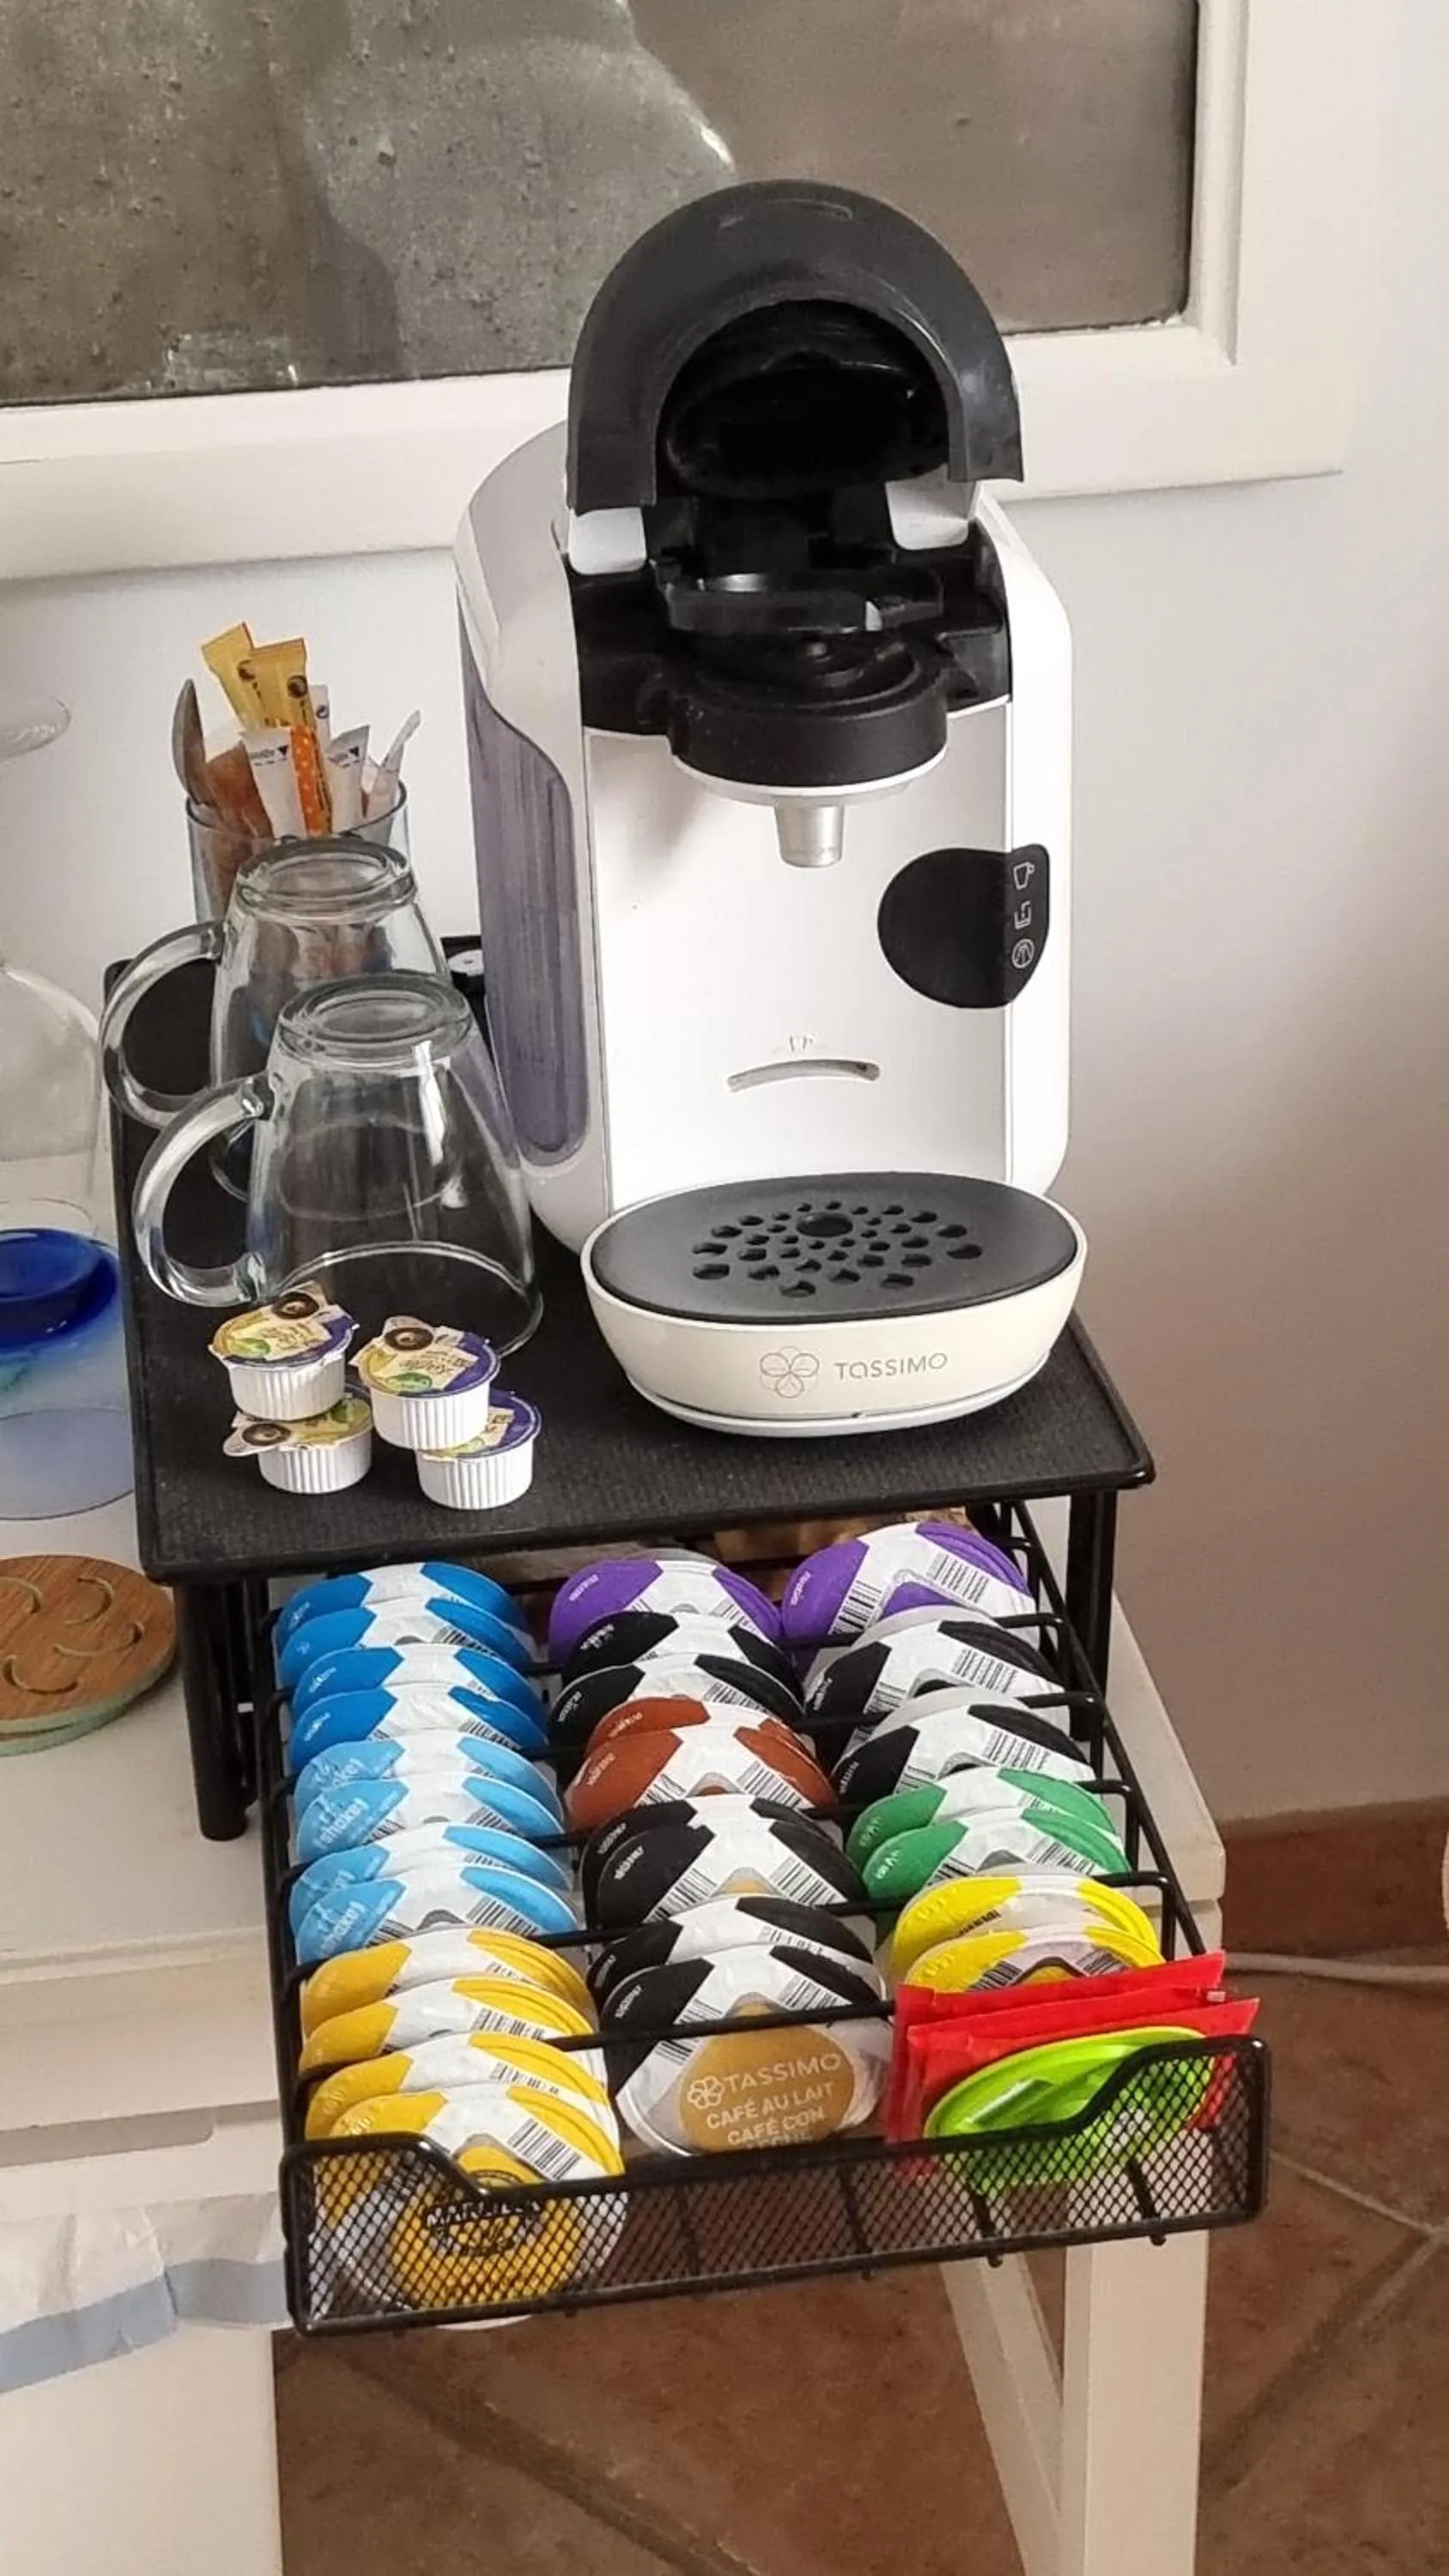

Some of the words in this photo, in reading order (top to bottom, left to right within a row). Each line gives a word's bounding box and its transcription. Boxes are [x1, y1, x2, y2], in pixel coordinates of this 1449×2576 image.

[833, 1352, 948, 1380] TASSIMO
[724, 2053, 841, 2093] TASSIMO
[706, 2099, 758, 2129] CAFÉ
[761, 2093, 789, 2115] AU
[793, 2081, 834, 2105] LAIT
[782, 2106, 825, 2133] CON
